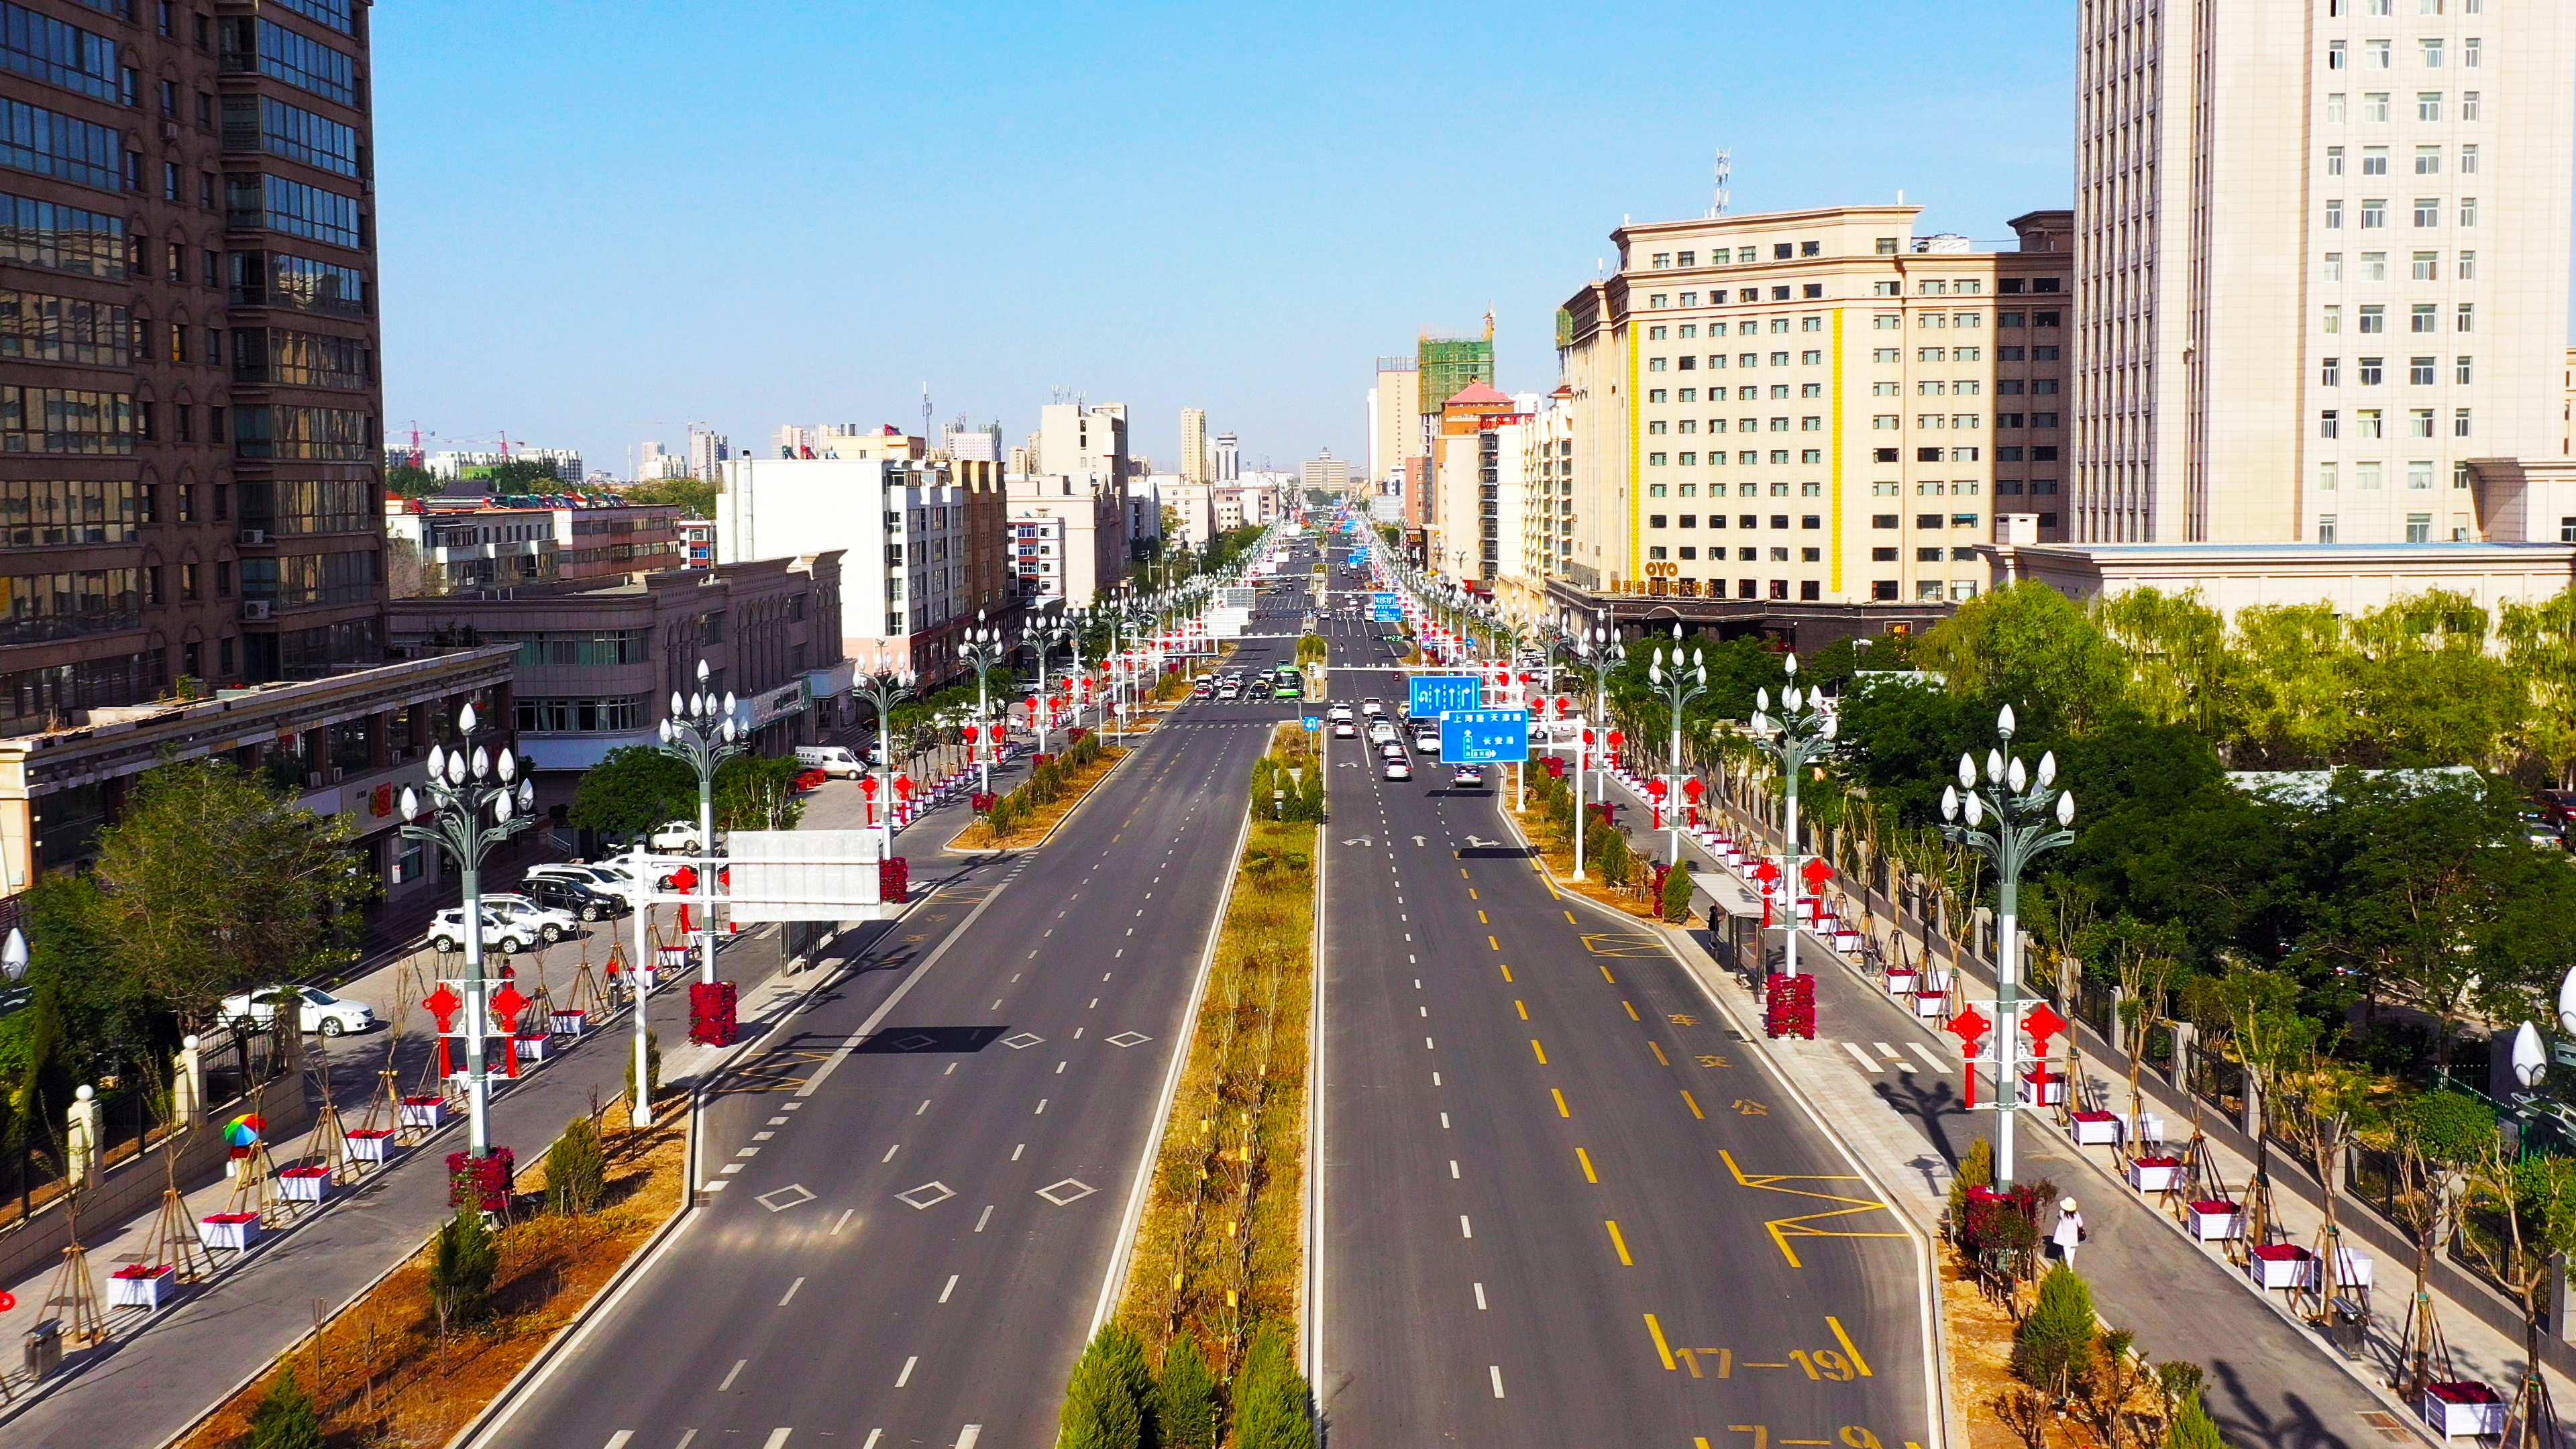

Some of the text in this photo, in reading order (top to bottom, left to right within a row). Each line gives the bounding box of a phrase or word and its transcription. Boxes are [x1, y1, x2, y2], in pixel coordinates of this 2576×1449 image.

[1645, 561, 1678, 577] OYO
[1452, 713, 1521, 723] 上海路 天津路
